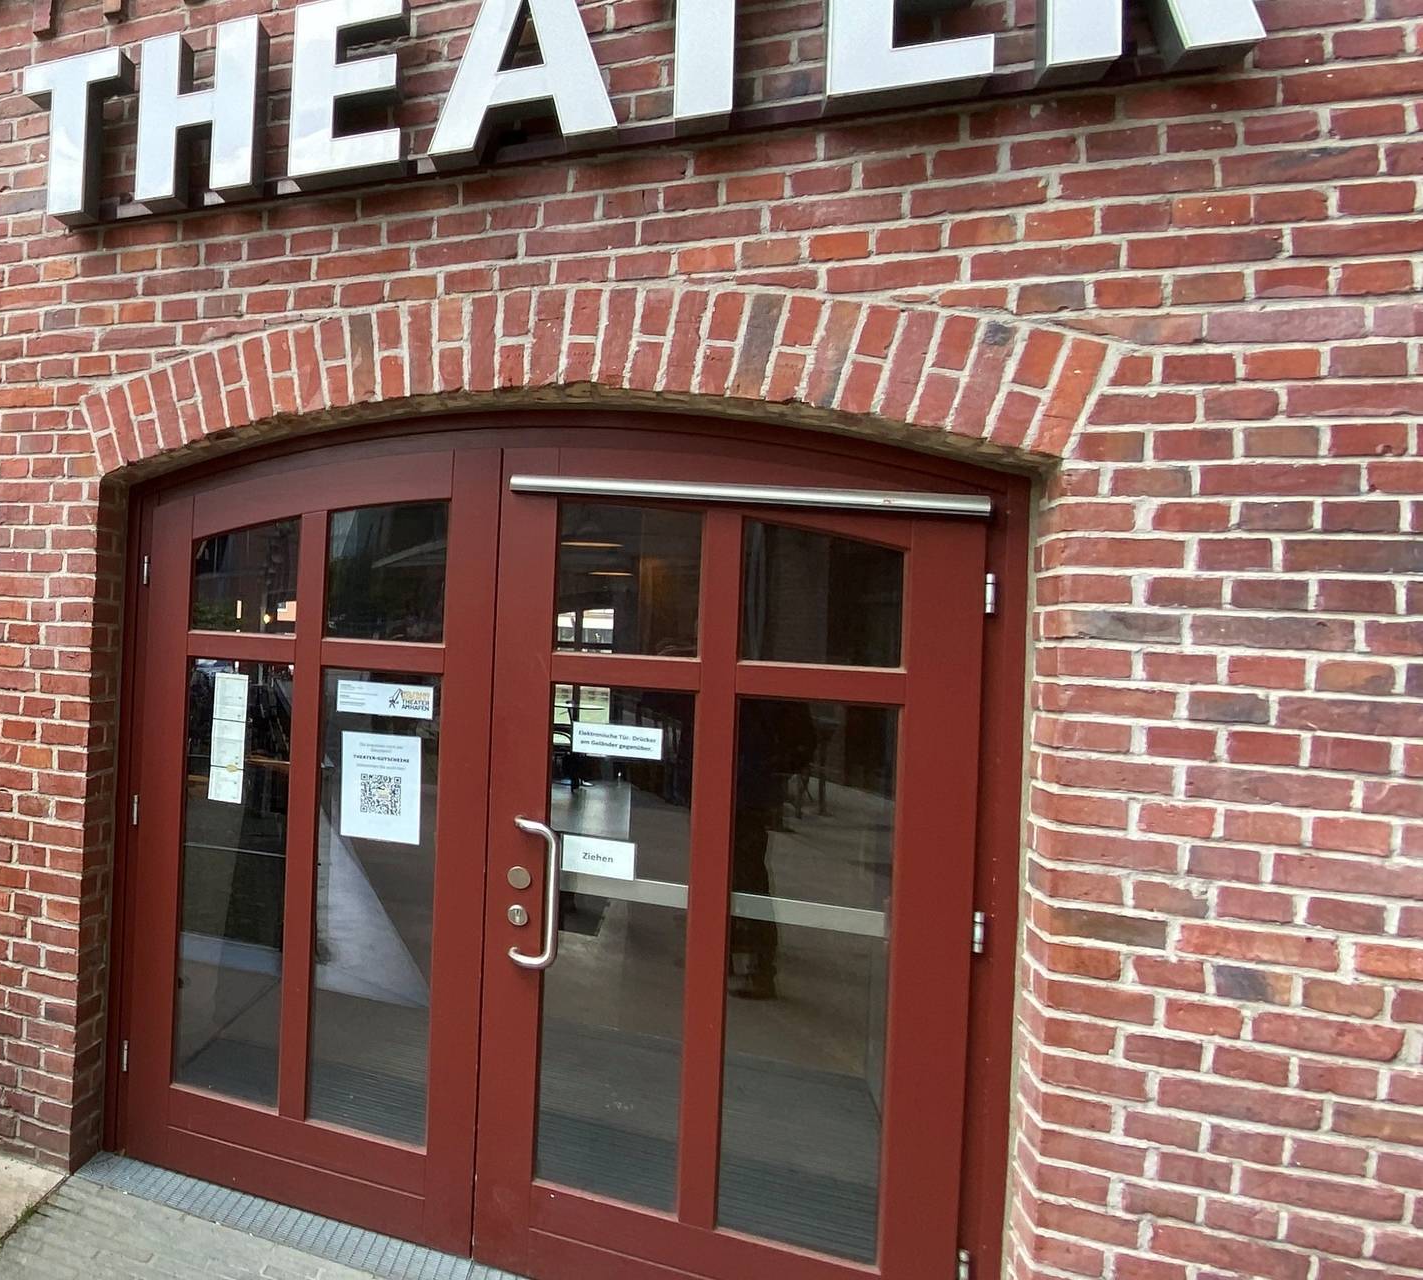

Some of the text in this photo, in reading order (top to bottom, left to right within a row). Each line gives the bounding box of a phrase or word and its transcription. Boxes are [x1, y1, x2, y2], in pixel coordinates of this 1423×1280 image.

[23, 0, 1267, 217] THEA
[591, 739, 618, 747] Geländer
[632, 735, 657, 743] Drücker
[582, 851, 614, 863] Ziehen
